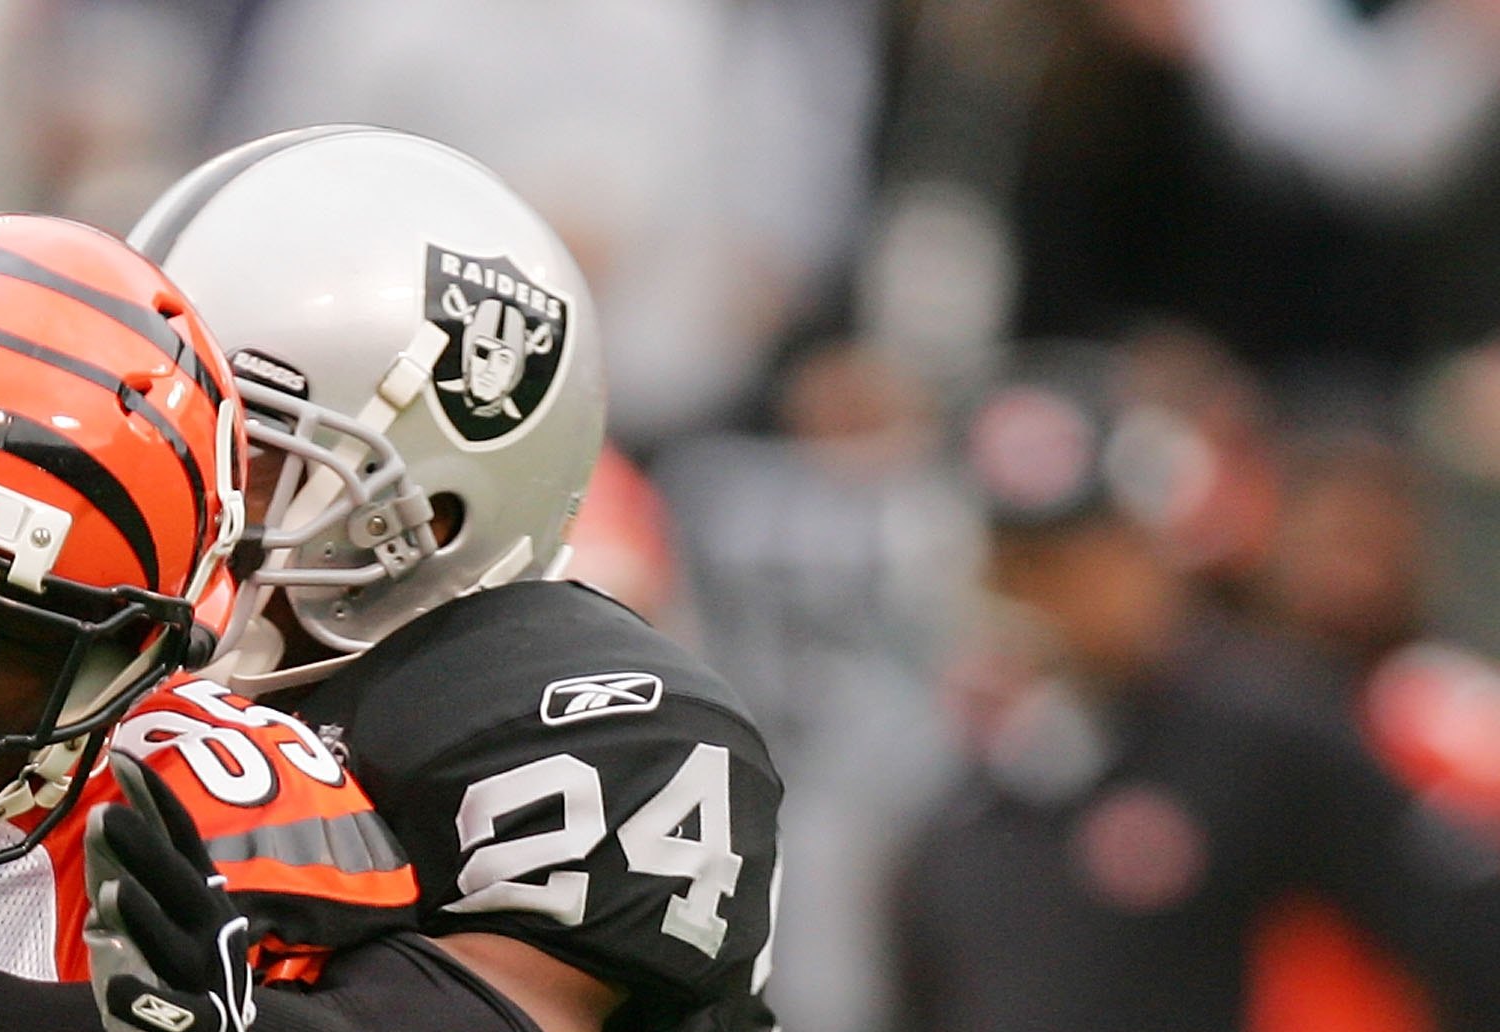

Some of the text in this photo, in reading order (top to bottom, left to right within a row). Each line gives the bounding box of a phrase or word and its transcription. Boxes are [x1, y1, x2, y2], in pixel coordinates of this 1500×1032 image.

[439, 252, 563, 320] RAIDERS
[109, 678, 347, 809] 85
[441, 741, 743, 960] 24
